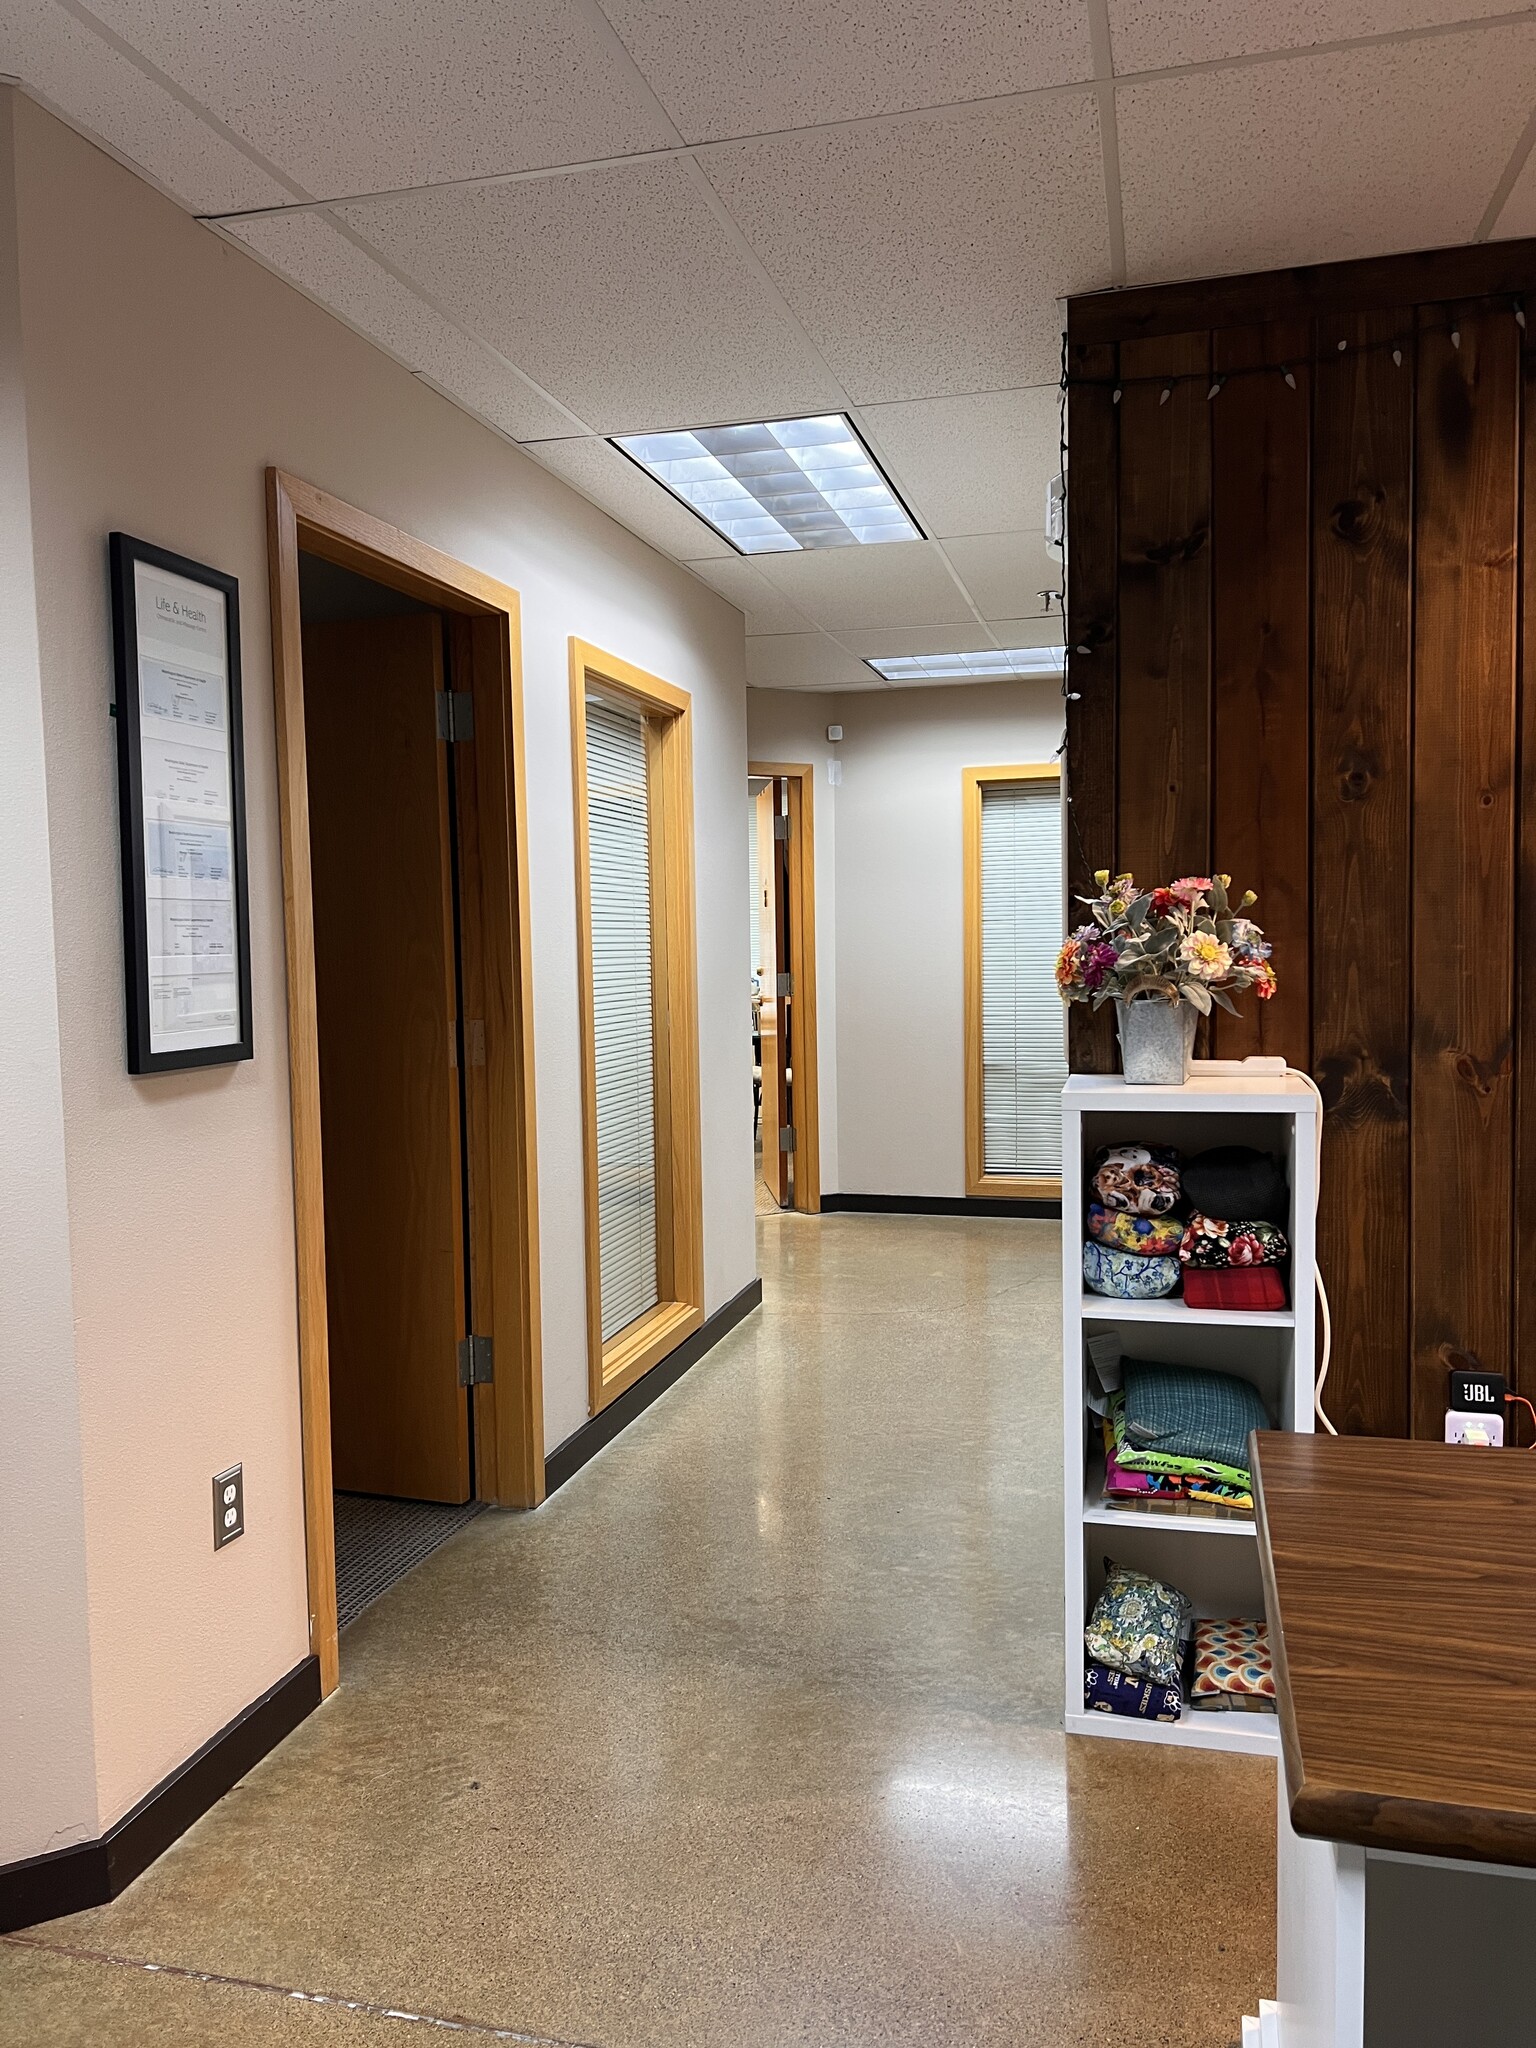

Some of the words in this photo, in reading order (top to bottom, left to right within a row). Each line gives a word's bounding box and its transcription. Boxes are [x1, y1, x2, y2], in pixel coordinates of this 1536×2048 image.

[155, 595, 171, 612] Life
[172, 601, 180, 615] &
[181, 604, 207, 624] Health
[1463, 1383, 1495, 1403] JBL
[1138, 1682, 1153, 1714] USKIES
